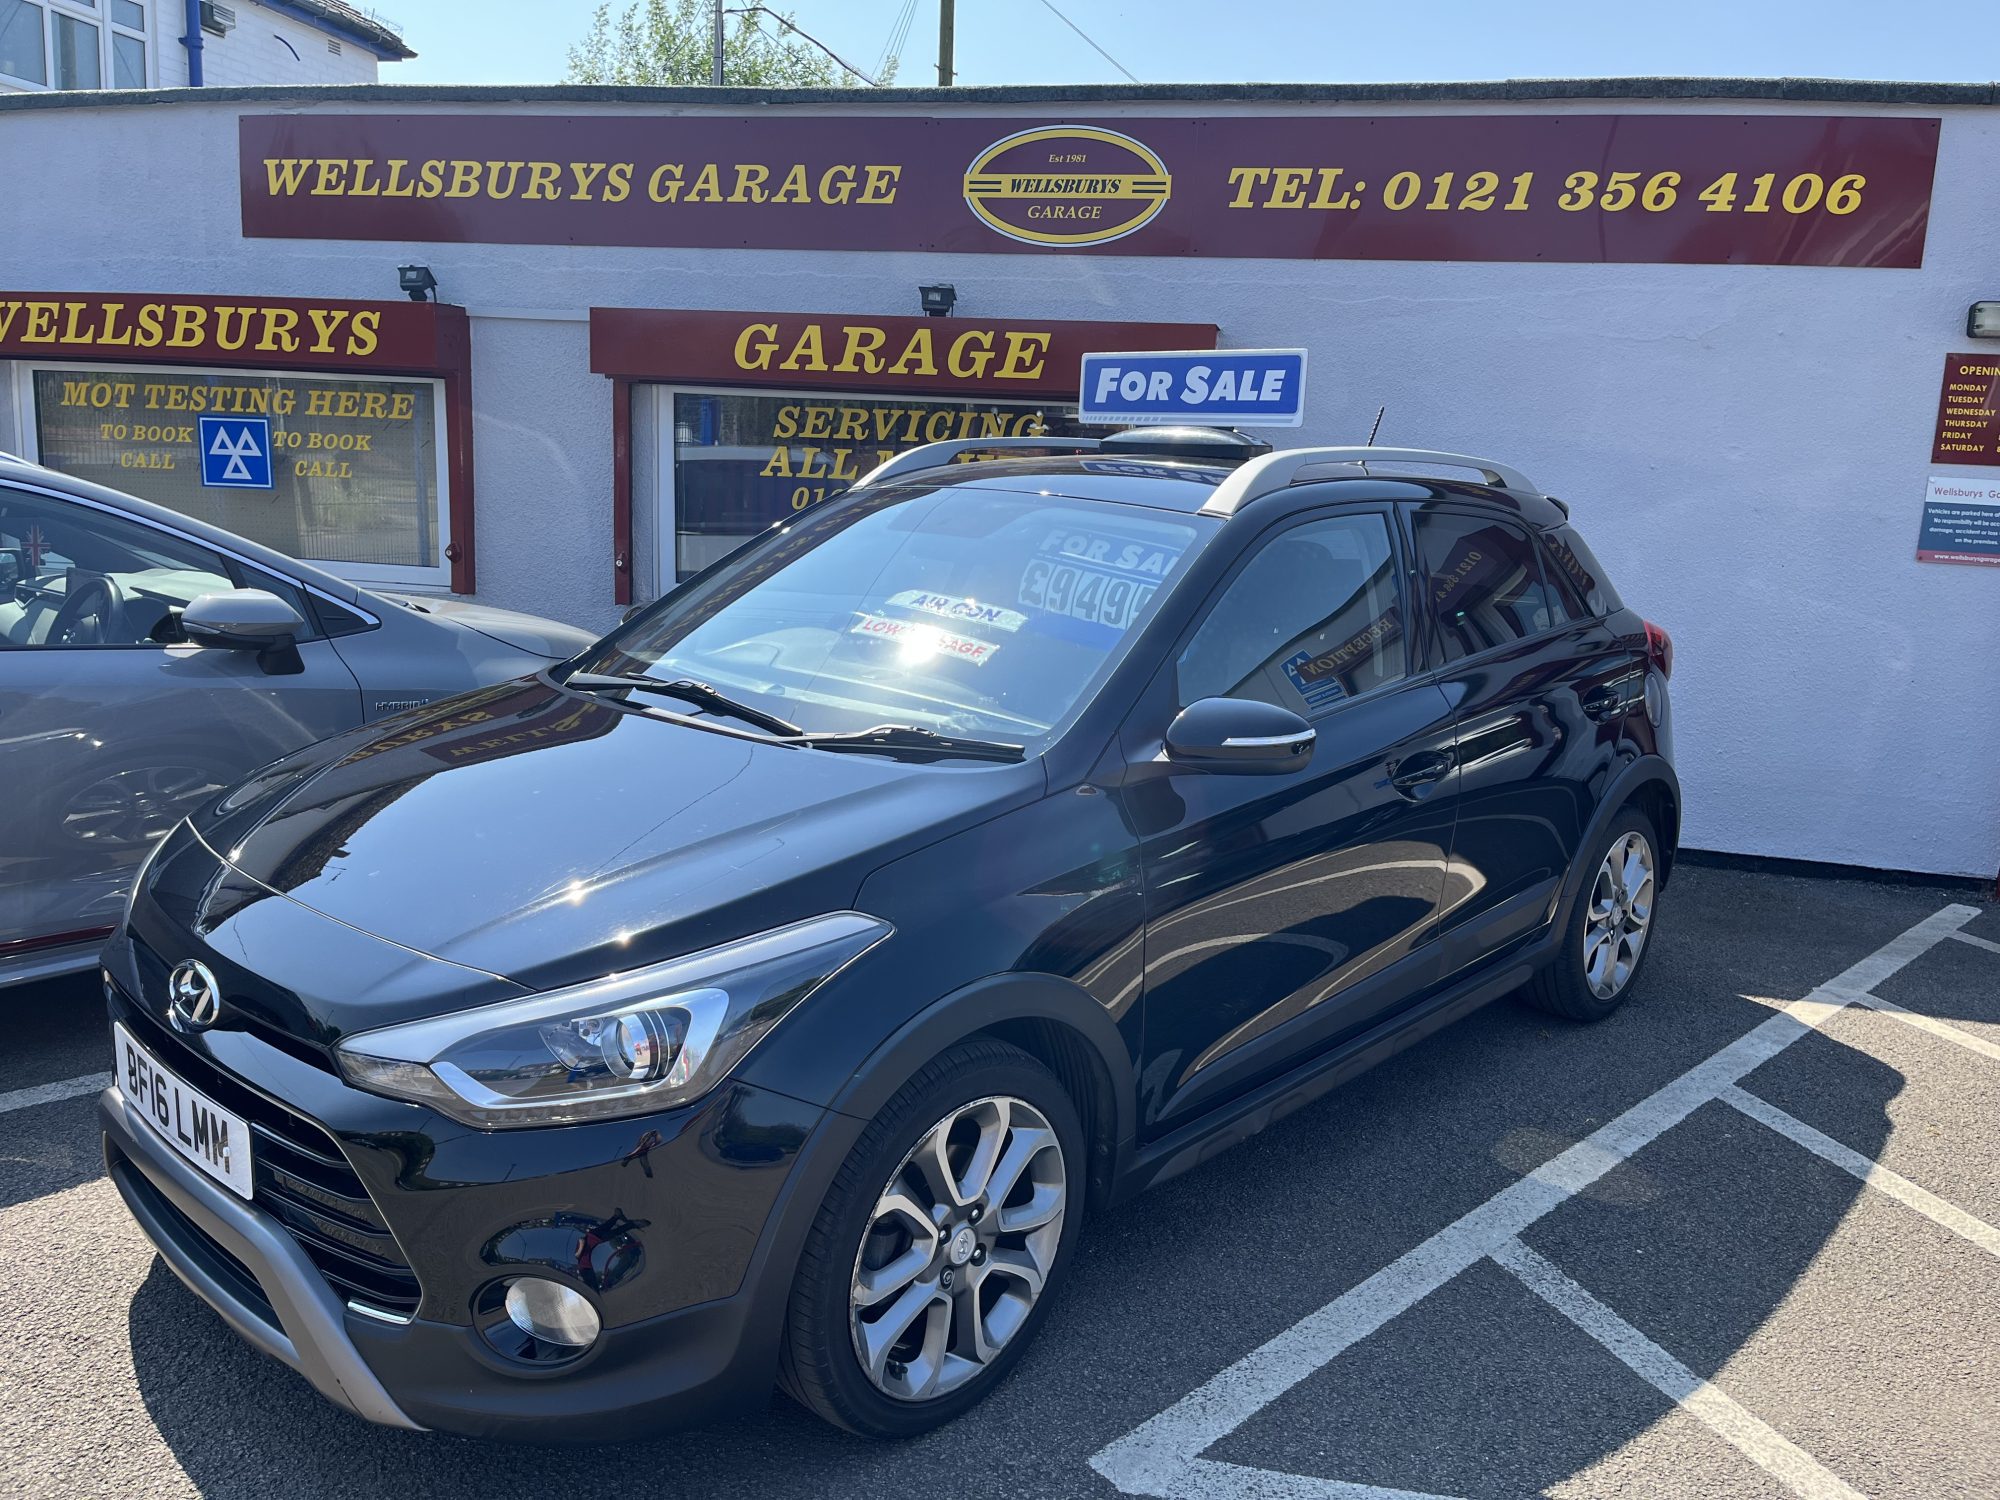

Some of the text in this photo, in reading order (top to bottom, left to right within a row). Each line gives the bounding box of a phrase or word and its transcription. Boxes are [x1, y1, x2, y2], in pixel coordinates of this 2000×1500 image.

[1048, 154, 1087, 163] Est 1981
[264, 158, 902, 205] WELLSBURYS GARAGE
[1010, 178, 1121, 194] WELLSBURYS
[1227, 167, 1867, 216] TEL: 0121 356 4106
[1027, 205, 1102, 219] GARAGE
[733, 322, 1052, 380] GARAGE
[1094, 365, 1286, 405] FOR SALE
[1949, 383, 1988, 392] MONDAY
[60, 382, 416, 421] MOT TESTING HERE
[1948, 395, 1985, 404] TUESDAY
[1946, 407, 1996, 417] WEDNESDAY
[101, 423, 194, 444] TO BOOK
[772, 406, 1047, 442] SERVICING
[1944, 419, 1988, 428] THURSDAY
[273, 430, 373, 452] TO BOOK
[1942, 431, 1973, 440] FRIDAY
[1940, 443, 1985, 452] SATURDAY
[120, 452, 176, 471] CALL
[294, 460, 353, 480] CALL
[760, 446, 858, 480] ALL
[1934, 487, 1983, 499] Wellsburys
[1039, 529, 1111, 562] FOR
[909, 594, 1001, 622] AIR CON
[126, 1041, 231, 1174] BF16 LMM
